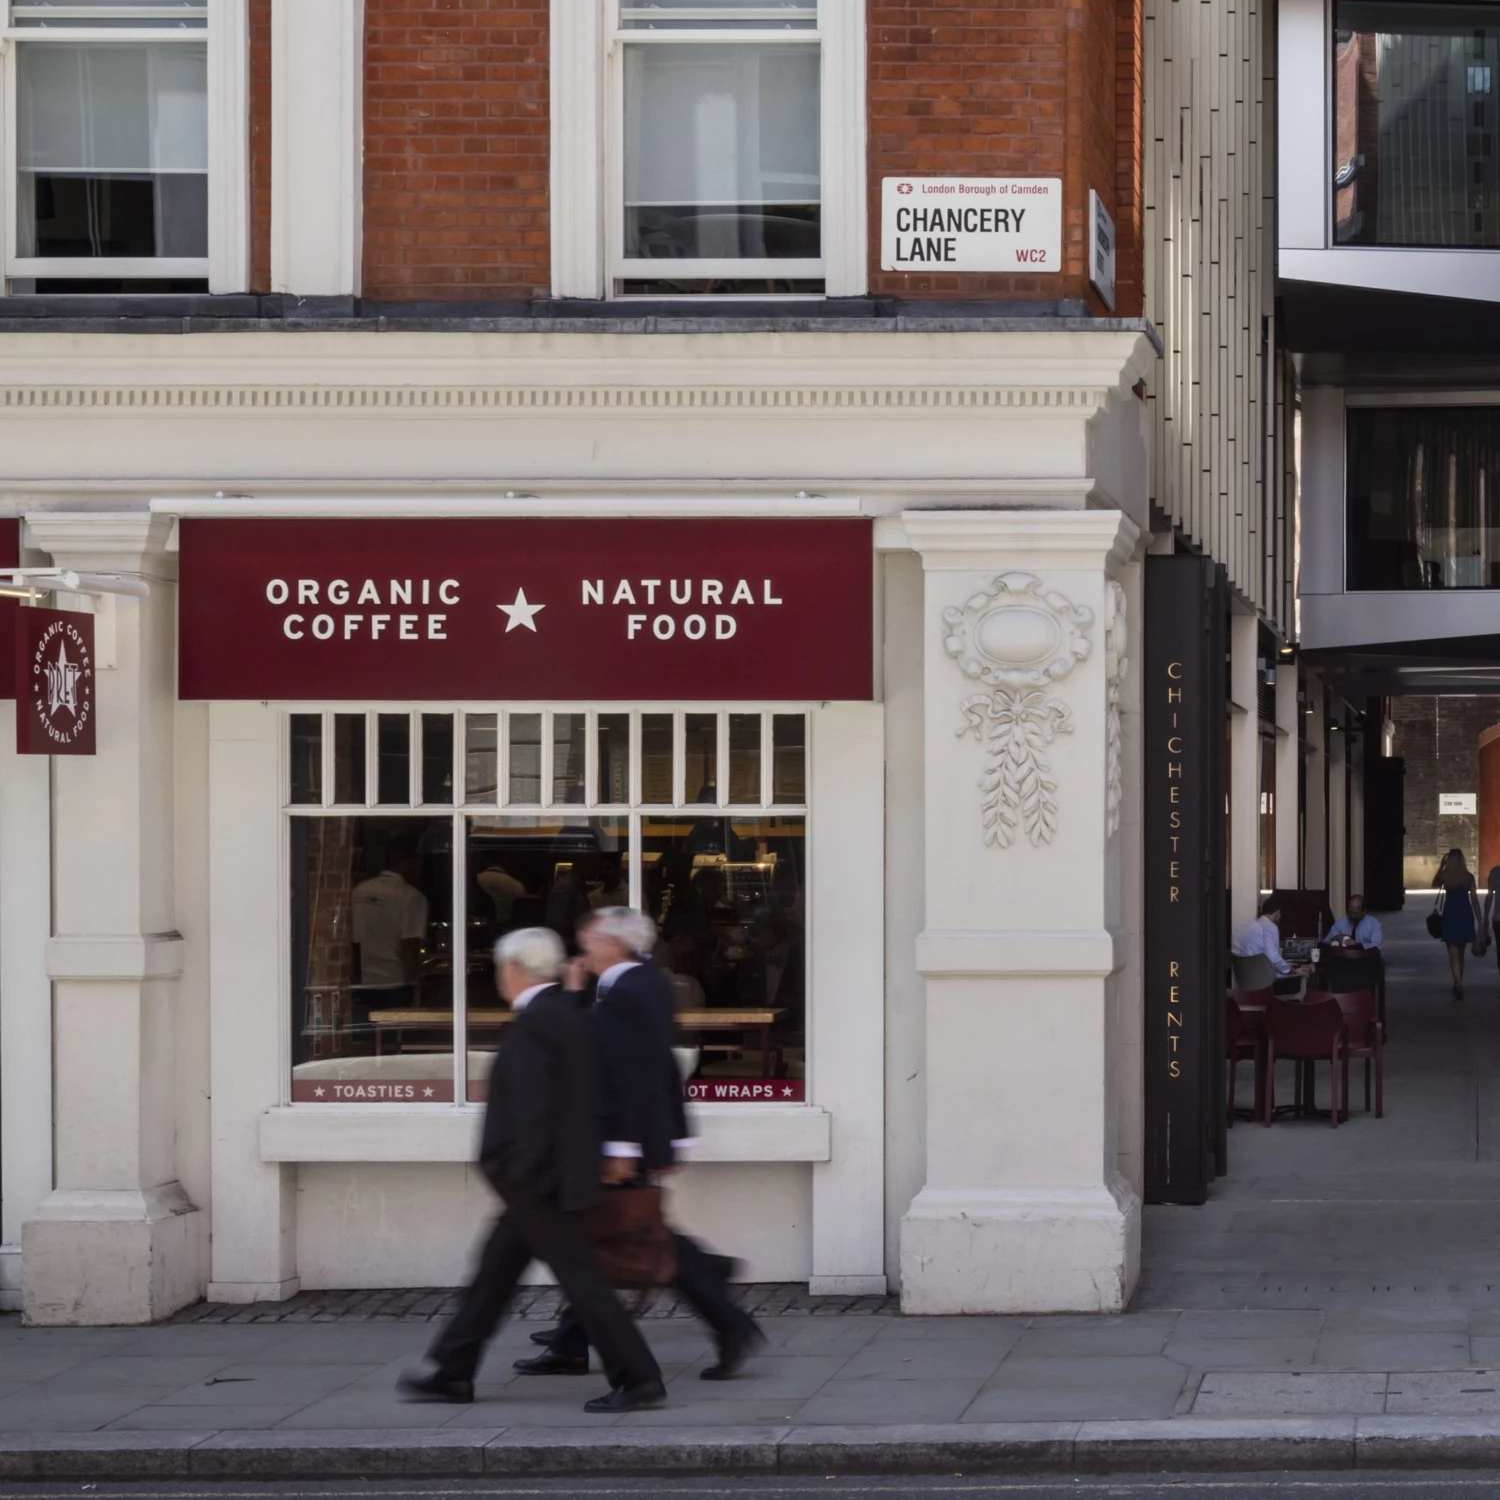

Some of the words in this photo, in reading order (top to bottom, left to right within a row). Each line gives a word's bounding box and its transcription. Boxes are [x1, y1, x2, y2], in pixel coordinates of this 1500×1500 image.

[922, 183, 955, 194] London
[958, 183, 996, 196] Borough
[999, 184, 1009, 194] of
[1011, 184, 1049, 195] Camden
[896, 207, 1026, 233] CHANCERY
[896, 237, 957, 262] LANE
[1015, 249, 1046, 263] WC2
[266, 578, 461, 605] ORGANIC
[582, 579, 783, 605] NATURAL
[283, 613, 448, 640] COFFEE
[627, 614, 737, 640] FOOD
[33, 620, 64, 675] ORGANIC
[66, 624, 91, 678] COFFEE
[47, 659, 79, 706] PRET
[35, 698, 72, 744] NATURAL
[72, 700, 90, 738] FOOD
[1167, 662, 1182, 904] CHICHESTER
[1167, 961, 1183, 1079] RENTS
[333, 1085, 415, 1098] TOASTIES
[714, 1085, 774, 1098] WRAPS
